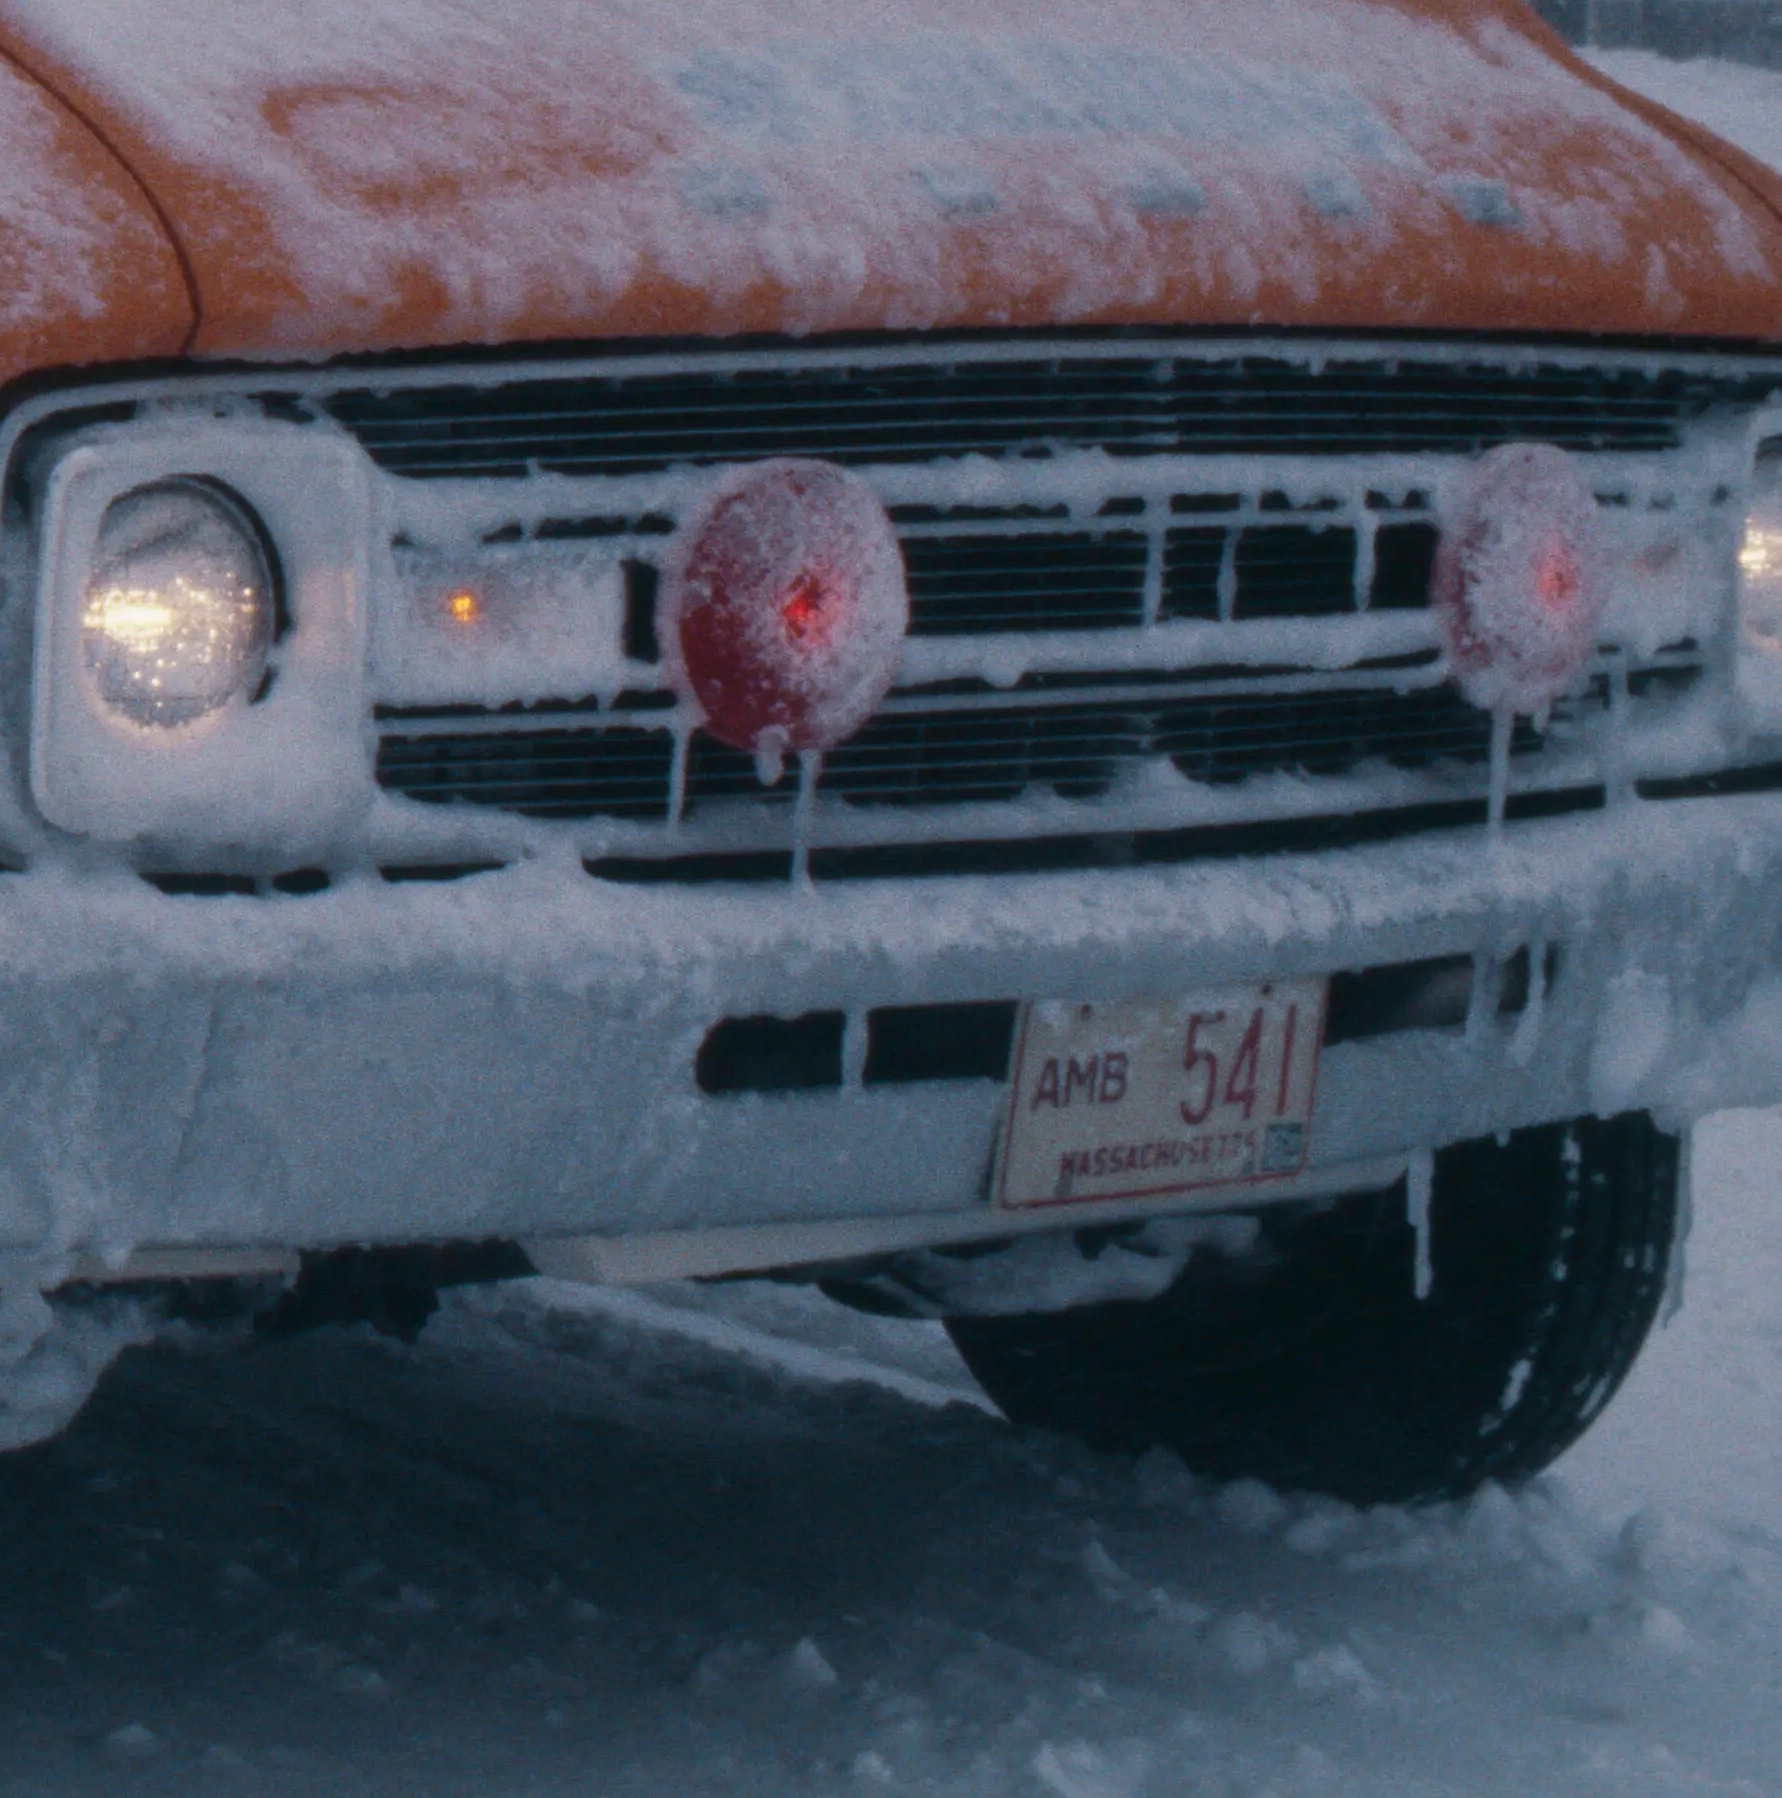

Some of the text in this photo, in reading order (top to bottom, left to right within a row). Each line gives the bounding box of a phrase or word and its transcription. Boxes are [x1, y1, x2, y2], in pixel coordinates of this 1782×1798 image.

[1033, 1004, 1298, 1125] AMB 541
[1061, 1131, 1257, 1178] MASSACHUSETTS
